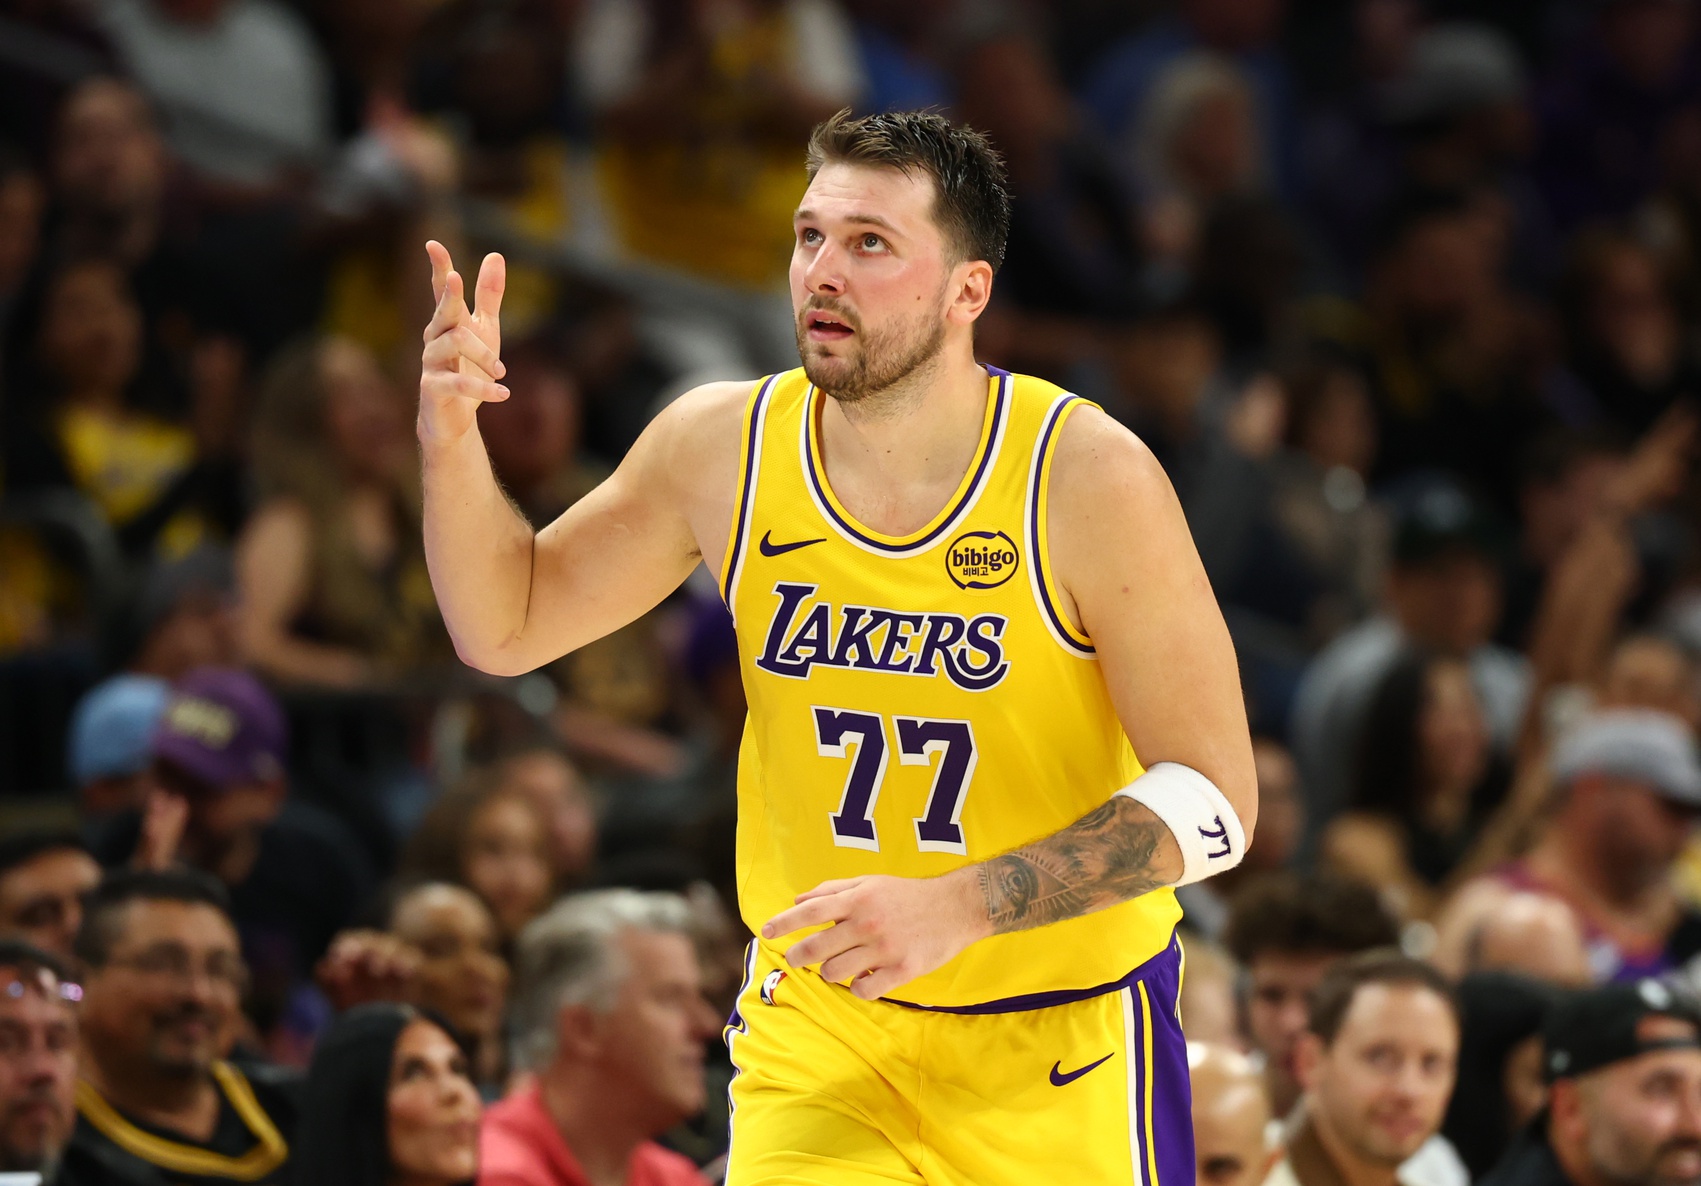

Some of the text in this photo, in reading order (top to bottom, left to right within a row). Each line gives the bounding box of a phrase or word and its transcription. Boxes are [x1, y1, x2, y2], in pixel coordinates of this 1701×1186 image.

[953, 546, 1014, 572] bibigo
[963, 567, 989, 577] 비비고
[755, 580, 1012, 693] LAKERS
[809, 704, 979, 857] 77
[1198, 815, 1231, 860] 77
